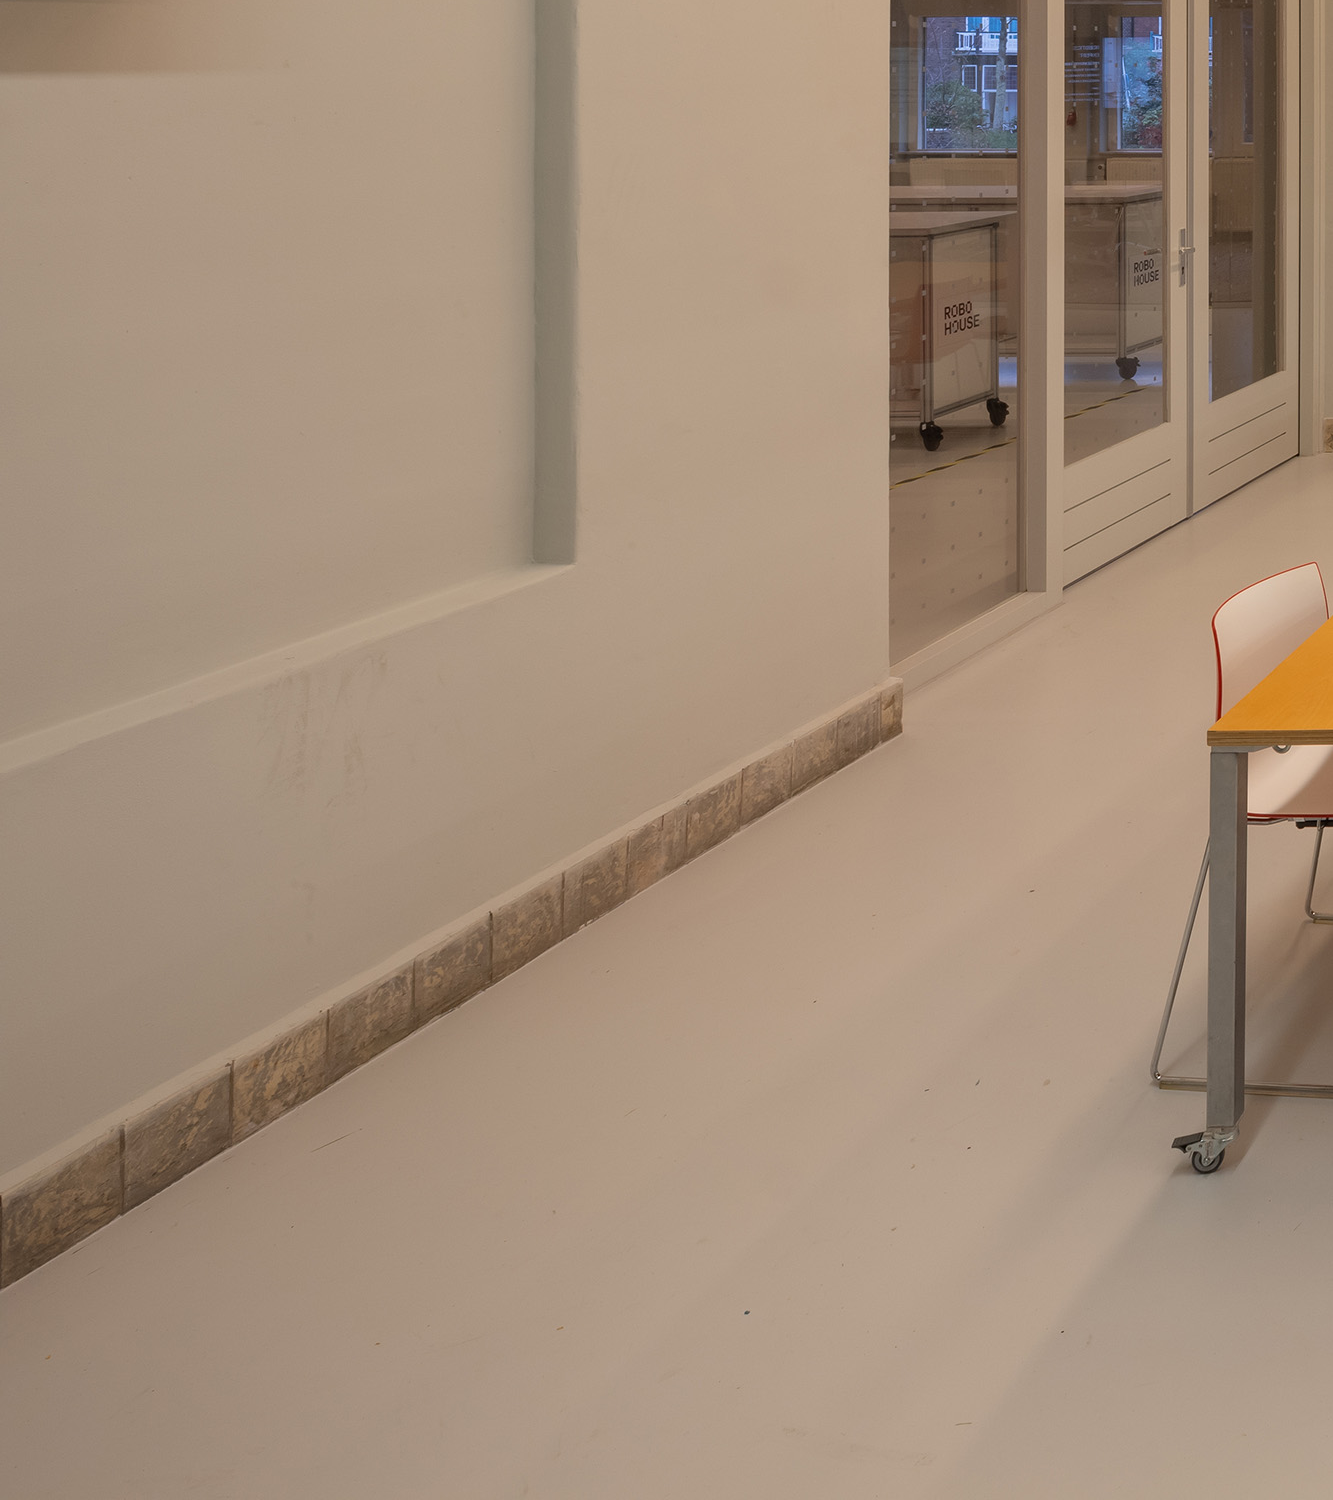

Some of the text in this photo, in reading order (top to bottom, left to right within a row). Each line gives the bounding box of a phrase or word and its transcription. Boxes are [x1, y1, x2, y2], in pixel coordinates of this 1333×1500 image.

[1134, 258, 1154, 274] ROBO
[1134, 270, 1159, 287] HOUSE
[944, 301, 972, 320] ROBO
[944, 314, 980, 336] HOUSE
